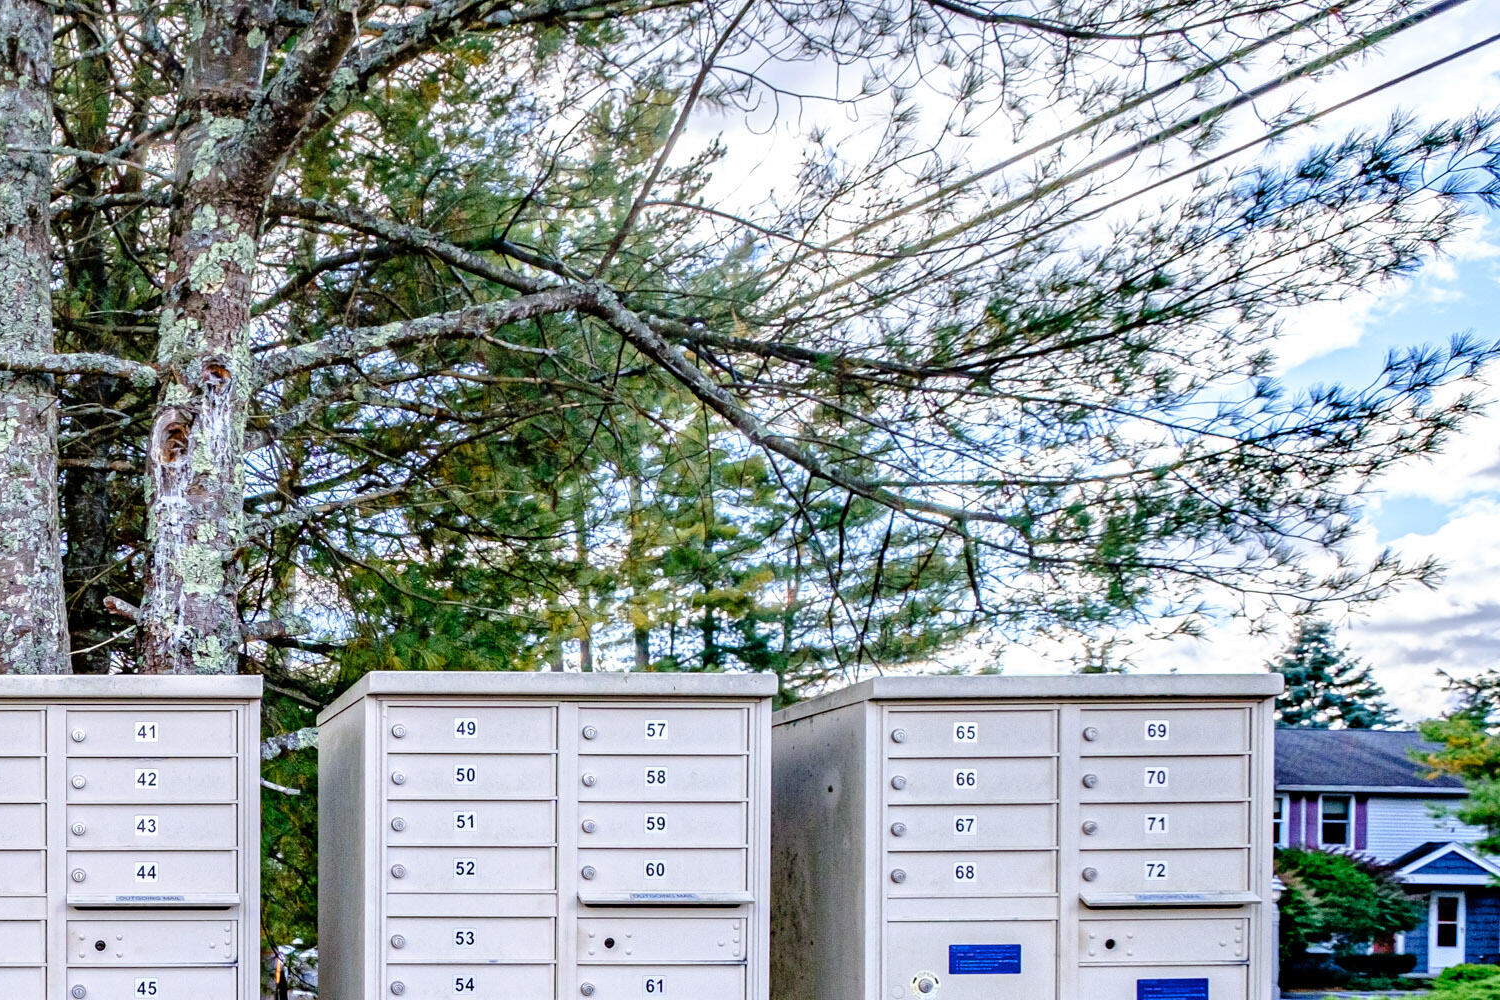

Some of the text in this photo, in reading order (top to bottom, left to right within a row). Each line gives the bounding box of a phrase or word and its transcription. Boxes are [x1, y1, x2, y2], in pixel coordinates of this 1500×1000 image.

[137, 724, 155, 739] 41
[456, 721, 476, 736] 49
[647, 723, 666, 737] 57
[956, 725, 976, 740] 65
[1147, 723, 1167, 738] 69
[137, 772, 157, 787] 42
[456, 767, 476, 782] 50
[646, 769, 666, 785] 58
[956, 772, 976, 786] 66
[1147, 770, 1166, 785] 70
[136, 818, 157, 833] 43
[456, 814, 474, 829] 51
[646, 816, 666, 831] 59
[955, 818, 974, 833] 67
[1147, 816, 1165, 831] 71
[136, 865, 157, 880] 44
[455, 861, 475, 876] 52
[645, 862, 665, 877] 60
[955, 865, 975, 880] 68
[1146, 863, 1166, 878] 72
[455, 931, 475, 946] 53
[136, 981, 157, 996] 45
[455, 977, 475, 992] 54
[645, 978, 663, 993] 61
